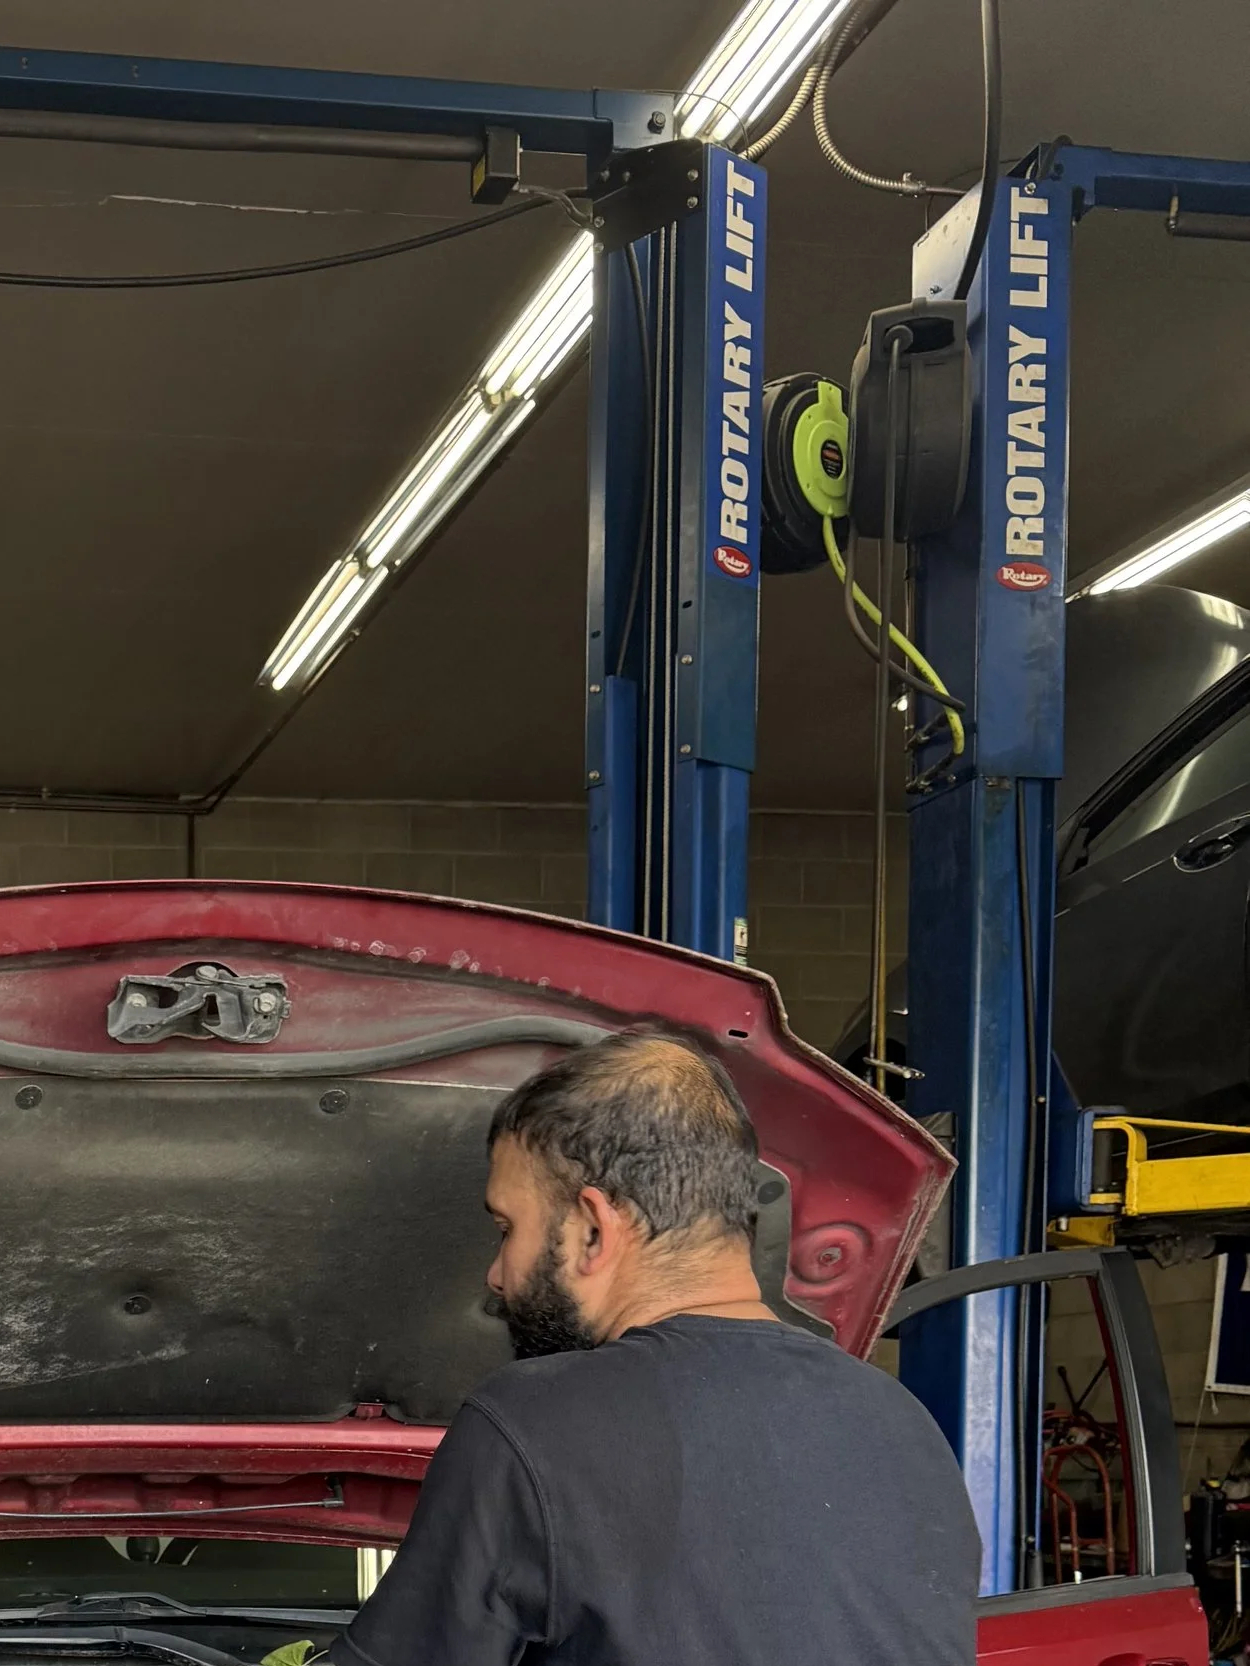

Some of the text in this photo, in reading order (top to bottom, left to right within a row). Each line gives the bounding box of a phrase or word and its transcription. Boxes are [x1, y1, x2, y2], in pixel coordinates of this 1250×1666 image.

[720, 159, 757, 545] ROTARY LIFT
[1005, 186, 1051, 557] ROTARY LIFT
[717, 547, 749, 573] Rotary
[1002, 567, 1047, 587] Rotary
